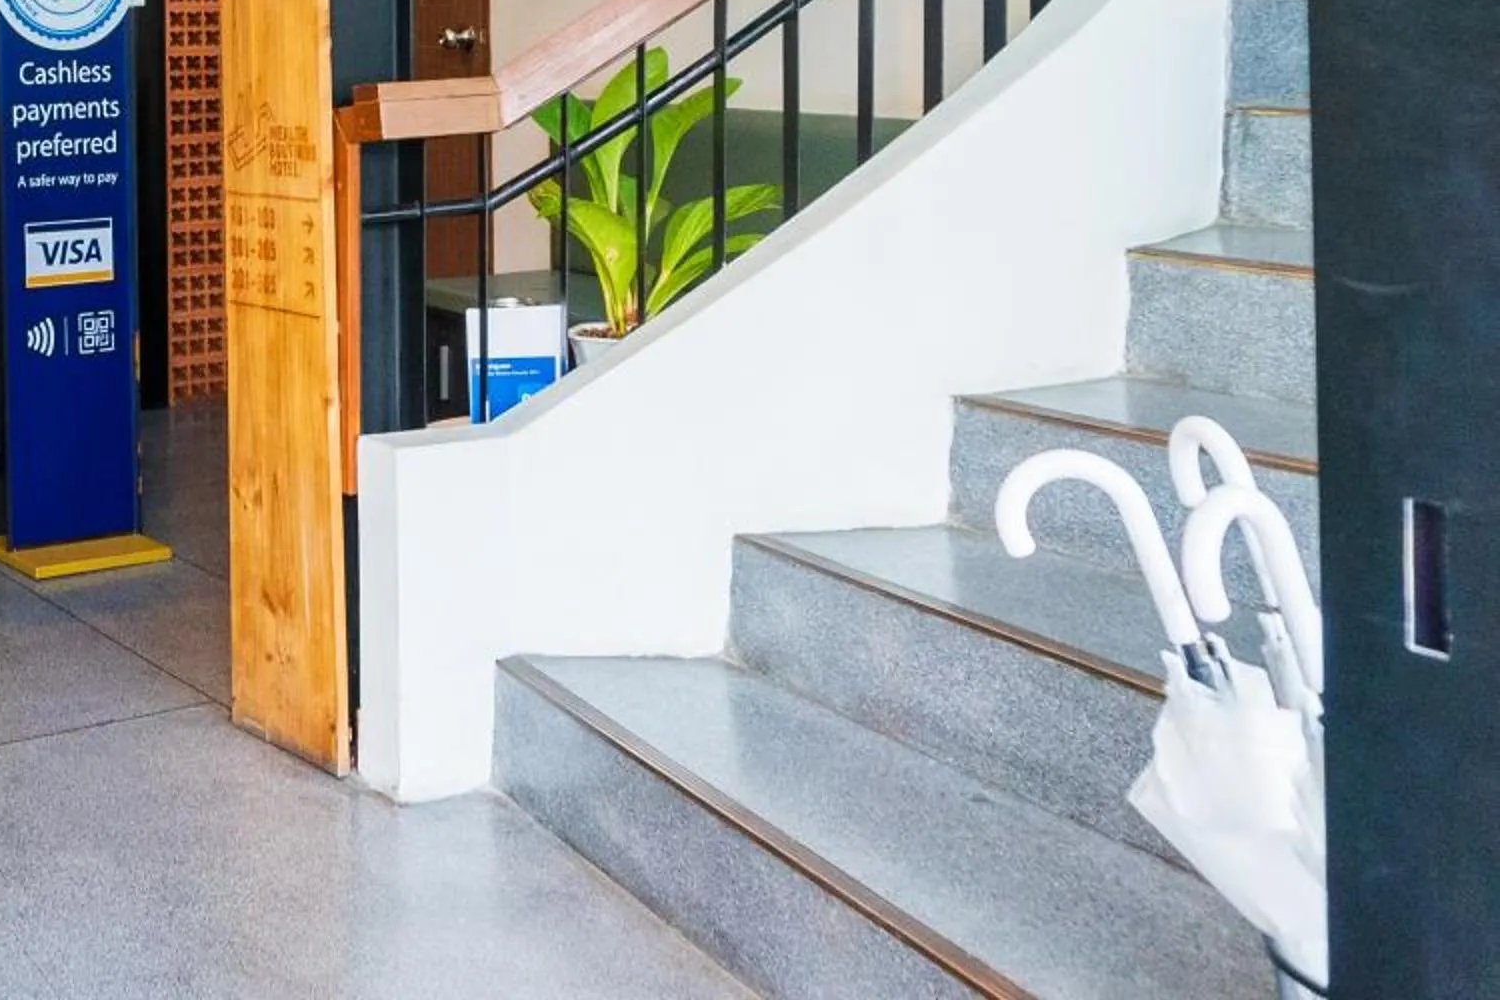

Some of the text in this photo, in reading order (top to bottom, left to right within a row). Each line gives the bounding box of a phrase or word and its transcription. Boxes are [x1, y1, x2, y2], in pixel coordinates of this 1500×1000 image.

[19, 60, 112, 85] Cashless
[12, 98, 121, 129] payments
[17, 129, 117, 165] preferred
[17, 172, 119, 188] A safer way to pay
[36, 238, 102, 266] VISA
